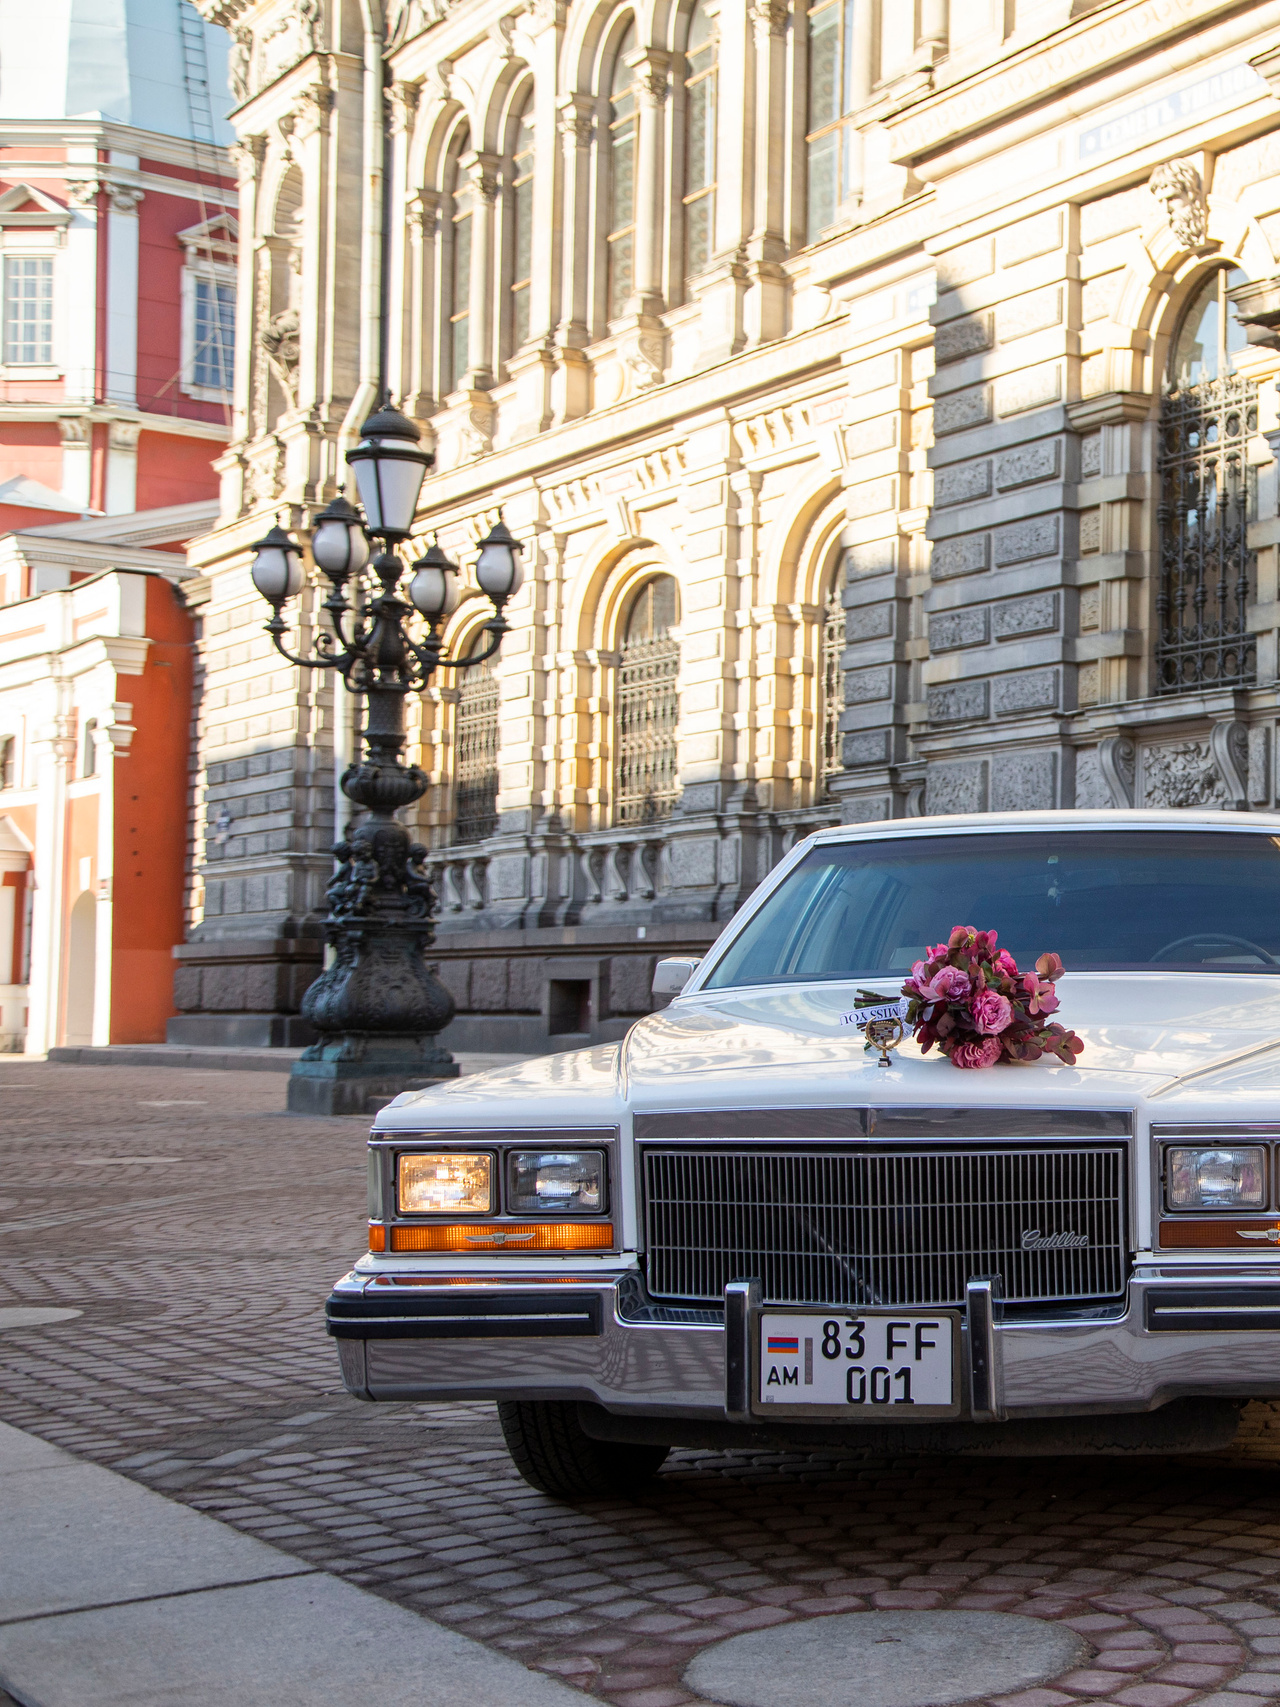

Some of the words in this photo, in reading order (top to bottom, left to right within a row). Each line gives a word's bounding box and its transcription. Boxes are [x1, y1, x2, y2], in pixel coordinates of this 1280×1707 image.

[840, 1012, 867, 1026] YOU
[870, 1006, 899, 1020] MISS
[1021, 1229, 1089, 1250] Cadillac
[821, 1320, 866, 1360] 83
[886, 1322, 940, 1361] FF
[766, 1365, 799, 1386] AM
[846, 1365, 915, 1404] 001
